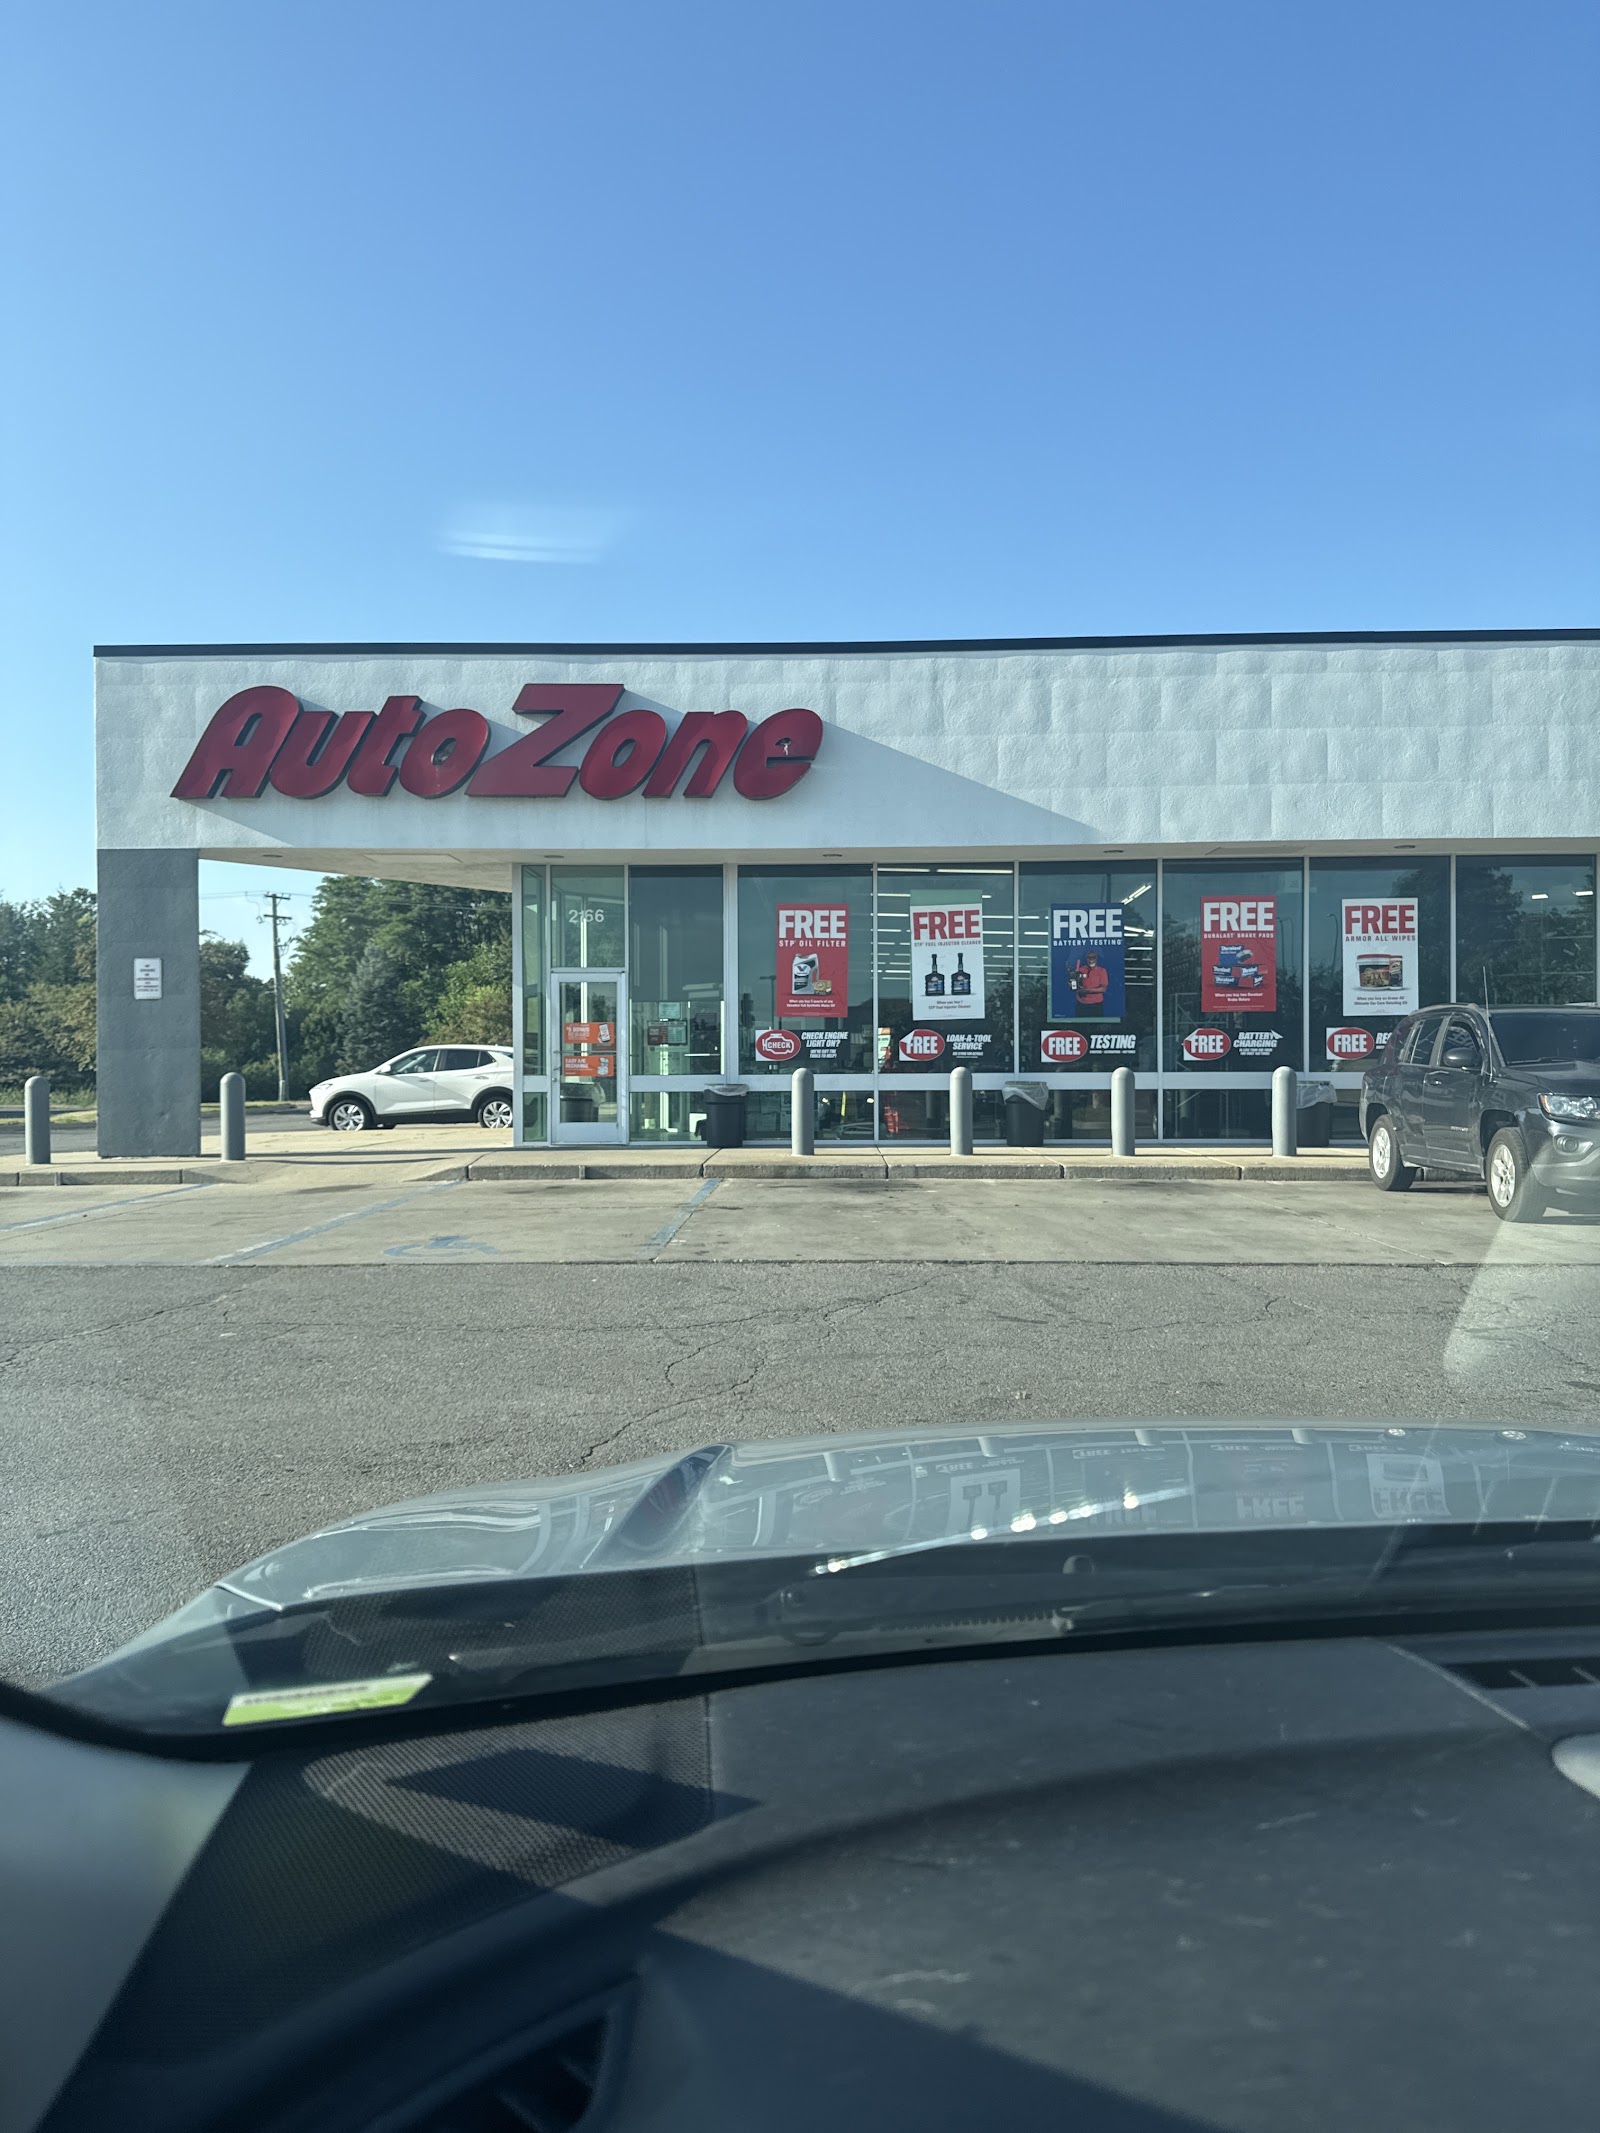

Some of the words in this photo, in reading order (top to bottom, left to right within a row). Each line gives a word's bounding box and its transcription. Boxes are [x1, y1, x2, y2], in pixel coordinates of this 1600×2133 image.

[170, 683, 824, 800] AutoZone
[568, 908, 605, 923] 2166
[778, 909, 846, 939] FREE
[912, 909, 981, 940] FREE
[1053, 908, 1122, 939] FREE
[1203, 901, 1274, 932] FREE
[1345, 904, 1415, 935] FREE
[906, 1036, 938, 1054] FREE
[946, 1034, 992, 1042] LOAN-A-TOOL
[1048, 1037, 1080, 1055] FREE
[1090, 1034, 1136, 1049] TESTING
[1191, 1035, 1223, 1053] FREE
[1233, 1040, 1277, 1048] CHARGING
[1334, 1034, 1367, 1053] FREE
